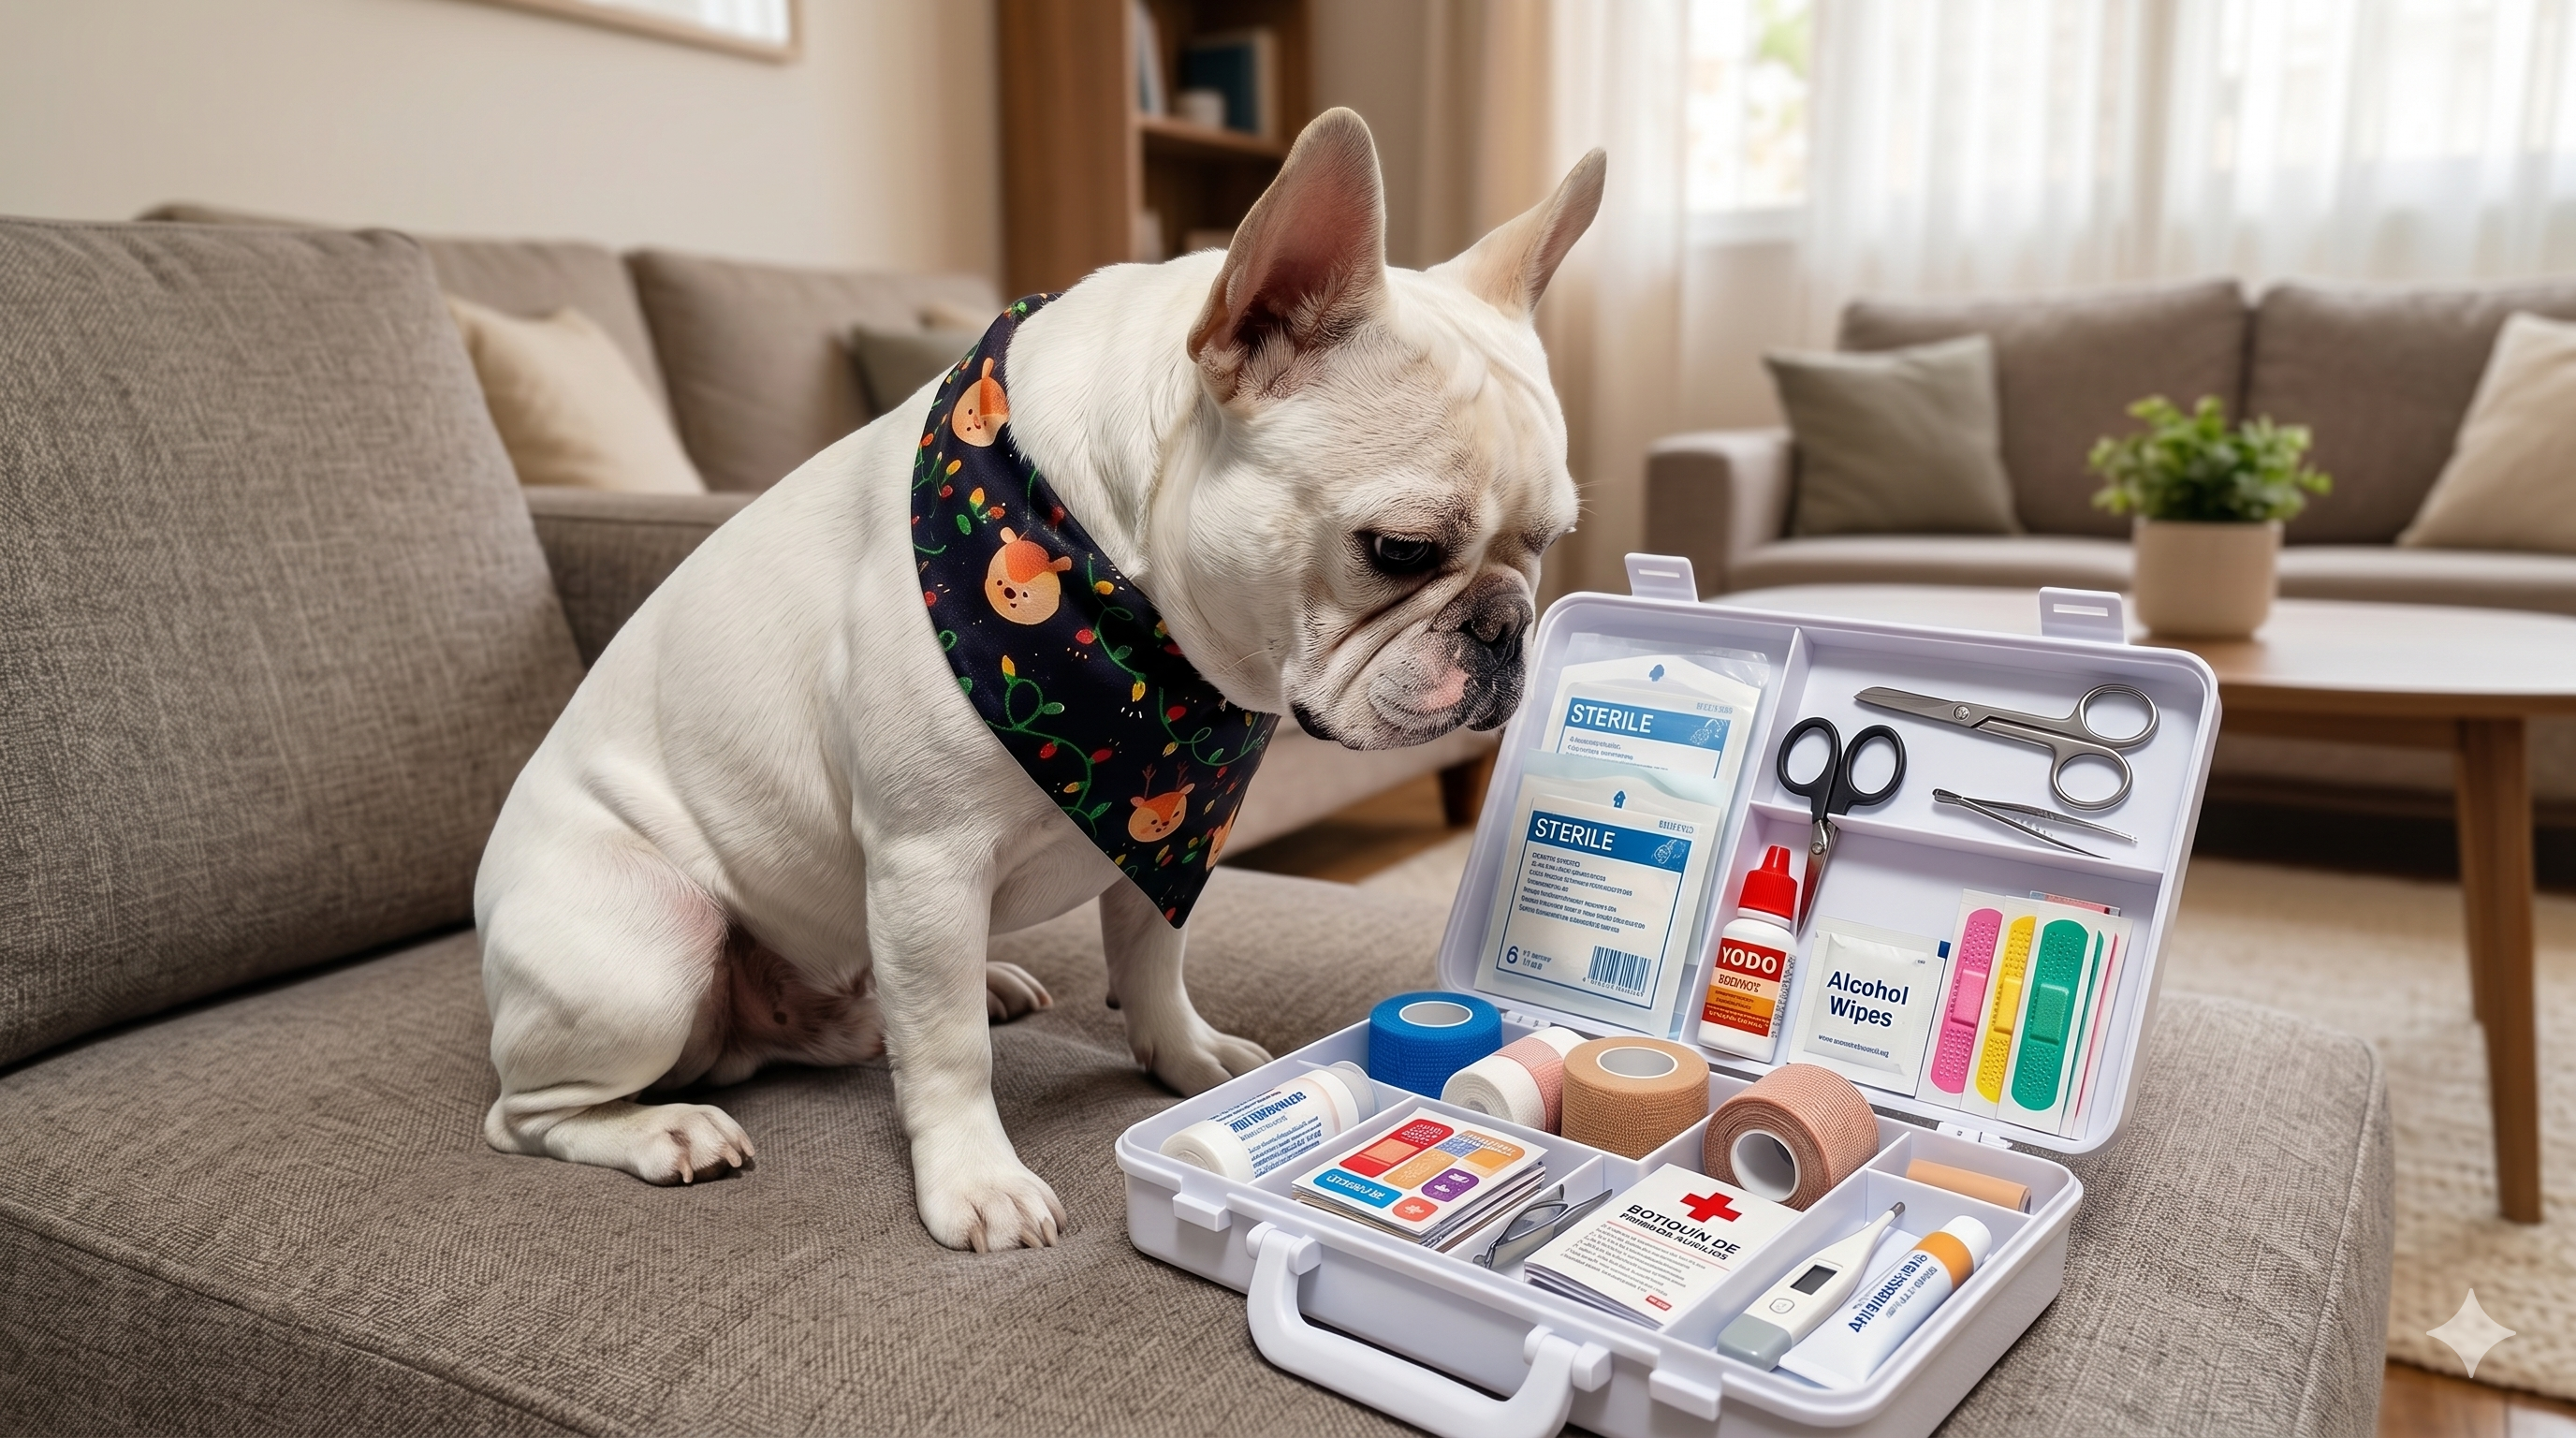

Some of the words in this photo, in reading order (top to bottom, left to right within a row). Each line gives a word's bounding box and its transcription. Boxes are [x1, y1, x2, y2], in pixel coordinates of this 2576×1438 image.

[1571, 704, 1654, 734] STERILE
[1535, 817, 1616, 851] STERILE
[1506, 946, 1519, 964] 6
[1722, 946, 1778, 975] YODO
[1826, 971, 1910, 1005] Alcohol
[1830, 995, 1893, 1027] Wipes
[1712, 1239, 1741, 1255] DE
